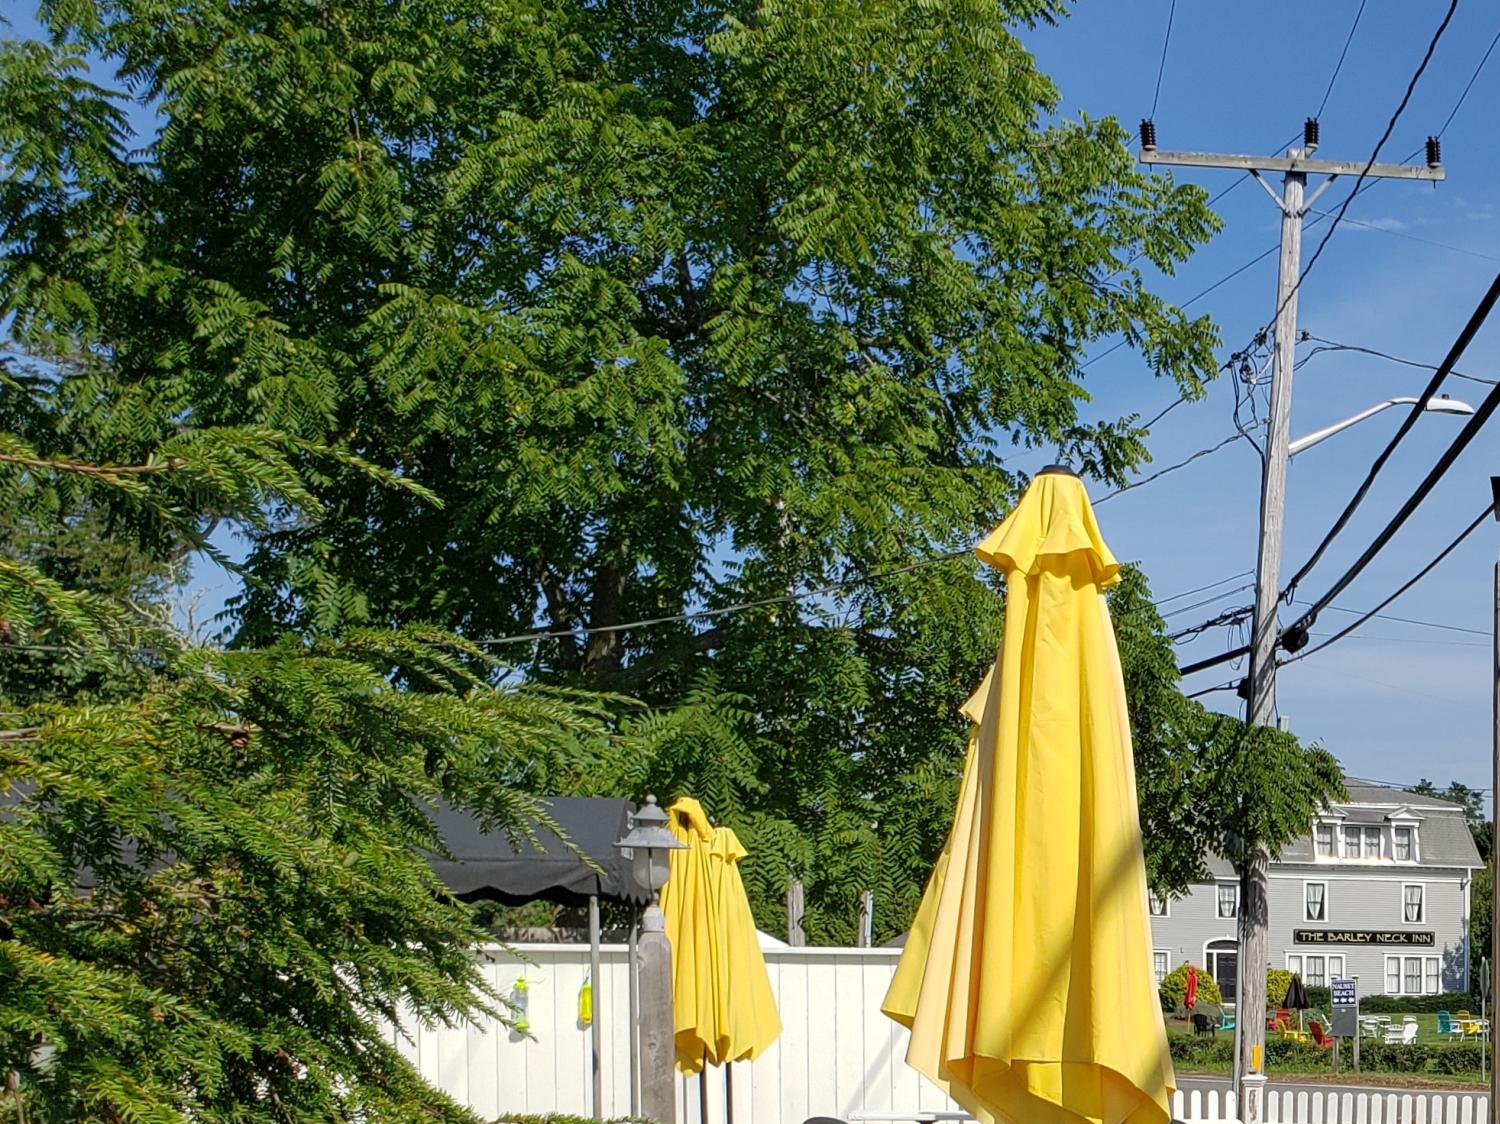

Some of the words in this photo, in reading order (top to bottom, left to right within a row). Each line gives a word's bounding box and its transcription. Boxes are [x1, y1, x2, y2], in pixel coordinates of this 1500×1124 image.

[1300, 932, 1324, 942] THE
[1328, 932, 1372, 942] BARLEY
[1376, 933, 1408, 943] NECK
[1412, 934, 1431, 943] INN
